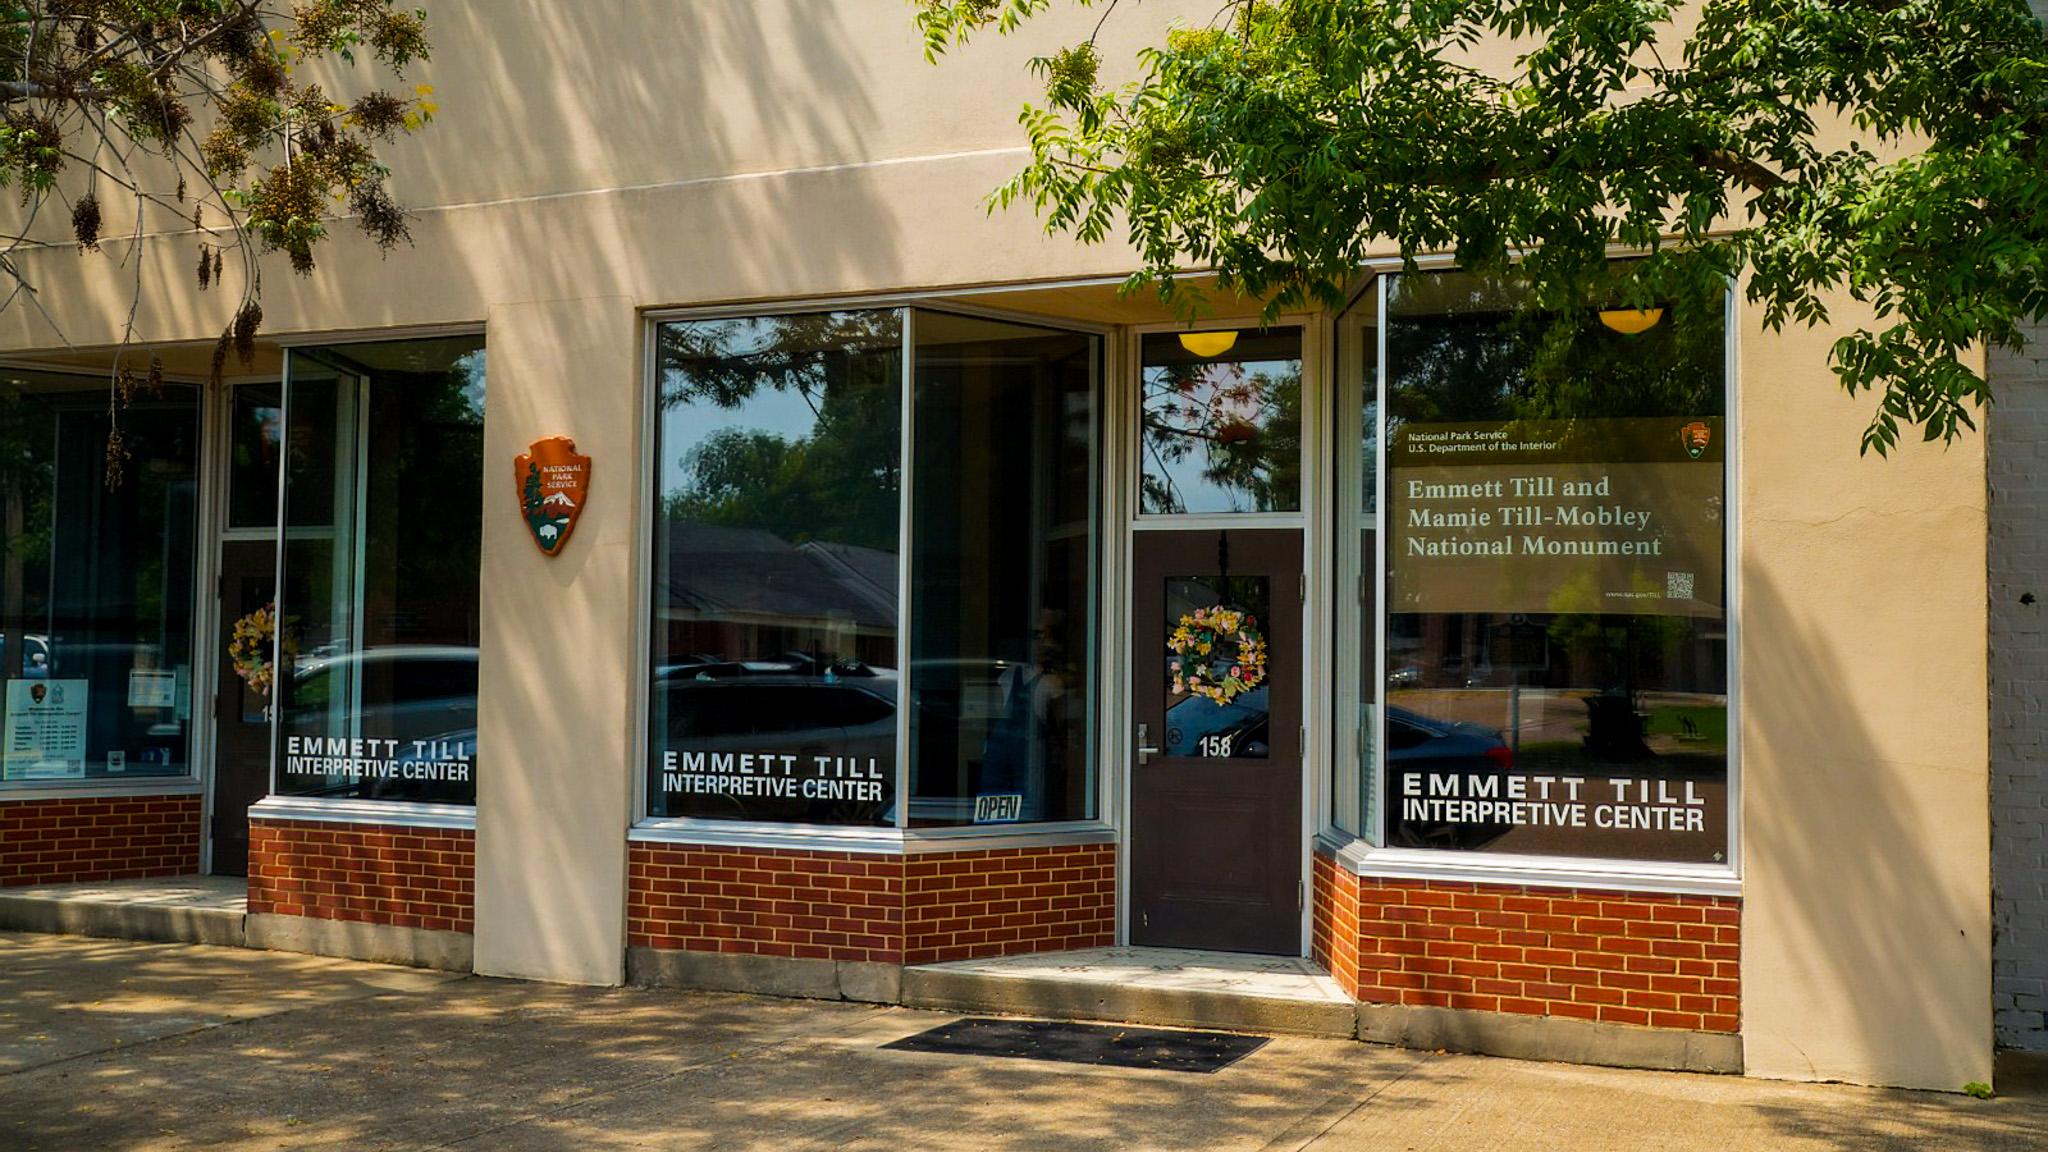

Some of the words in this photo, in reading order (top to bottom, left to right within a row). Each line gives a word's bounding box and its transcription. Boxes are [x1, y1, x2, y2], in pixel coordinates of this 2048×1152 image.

[1408, 431, 1448, 441] National
[1450, 431, 1472, 440] Park
[1474, 430, 1508, 440] Service
[1408, 444, 1427, 453] U.S.
[1429, 443, 1486, 455] Department
[1488, 442, 1499, 451] of
[1501, 441, 1517, 451] the
[1519, 441, 1557, 450] Interior
[543, 464, 582, 472] NATIONAL
[1408, 479, 1503, 499] Emmett
[1510, 477, 1554, 497] Till
[1562, 476, 1610, 496] and
[1408, 508, 1491, 527] Mamie
[1498, 506, 1651, 532] Till-Mobley
[1408, 536, 1512, 556] National
[1522, 536, 1662, 556] Monument
[288, 736, 398, 757] EMMETT
[413, 740, 469, 760] TILL
[1199, 735, 1231, 757] 158
[287, 757, 398, 778] INTERPRETIVE
[403, 761, 469, 781] CENTER
[663, 751, 797, 776] EMMETT
[814, 756, 884, 779] TILL
[663, 774, 797, 798] INTERPRETIVE
[803, 779, 883, 802] CENTER
[1403, 773, 1585, 801] EMMETT
[1609, 778, 1705, 805] TILL
[978, 796, 1018, 820] OPEN
[1403, 798, 1587, 827] INTERPRETIVE
[1594, 805, 1705, 831] CENTER
